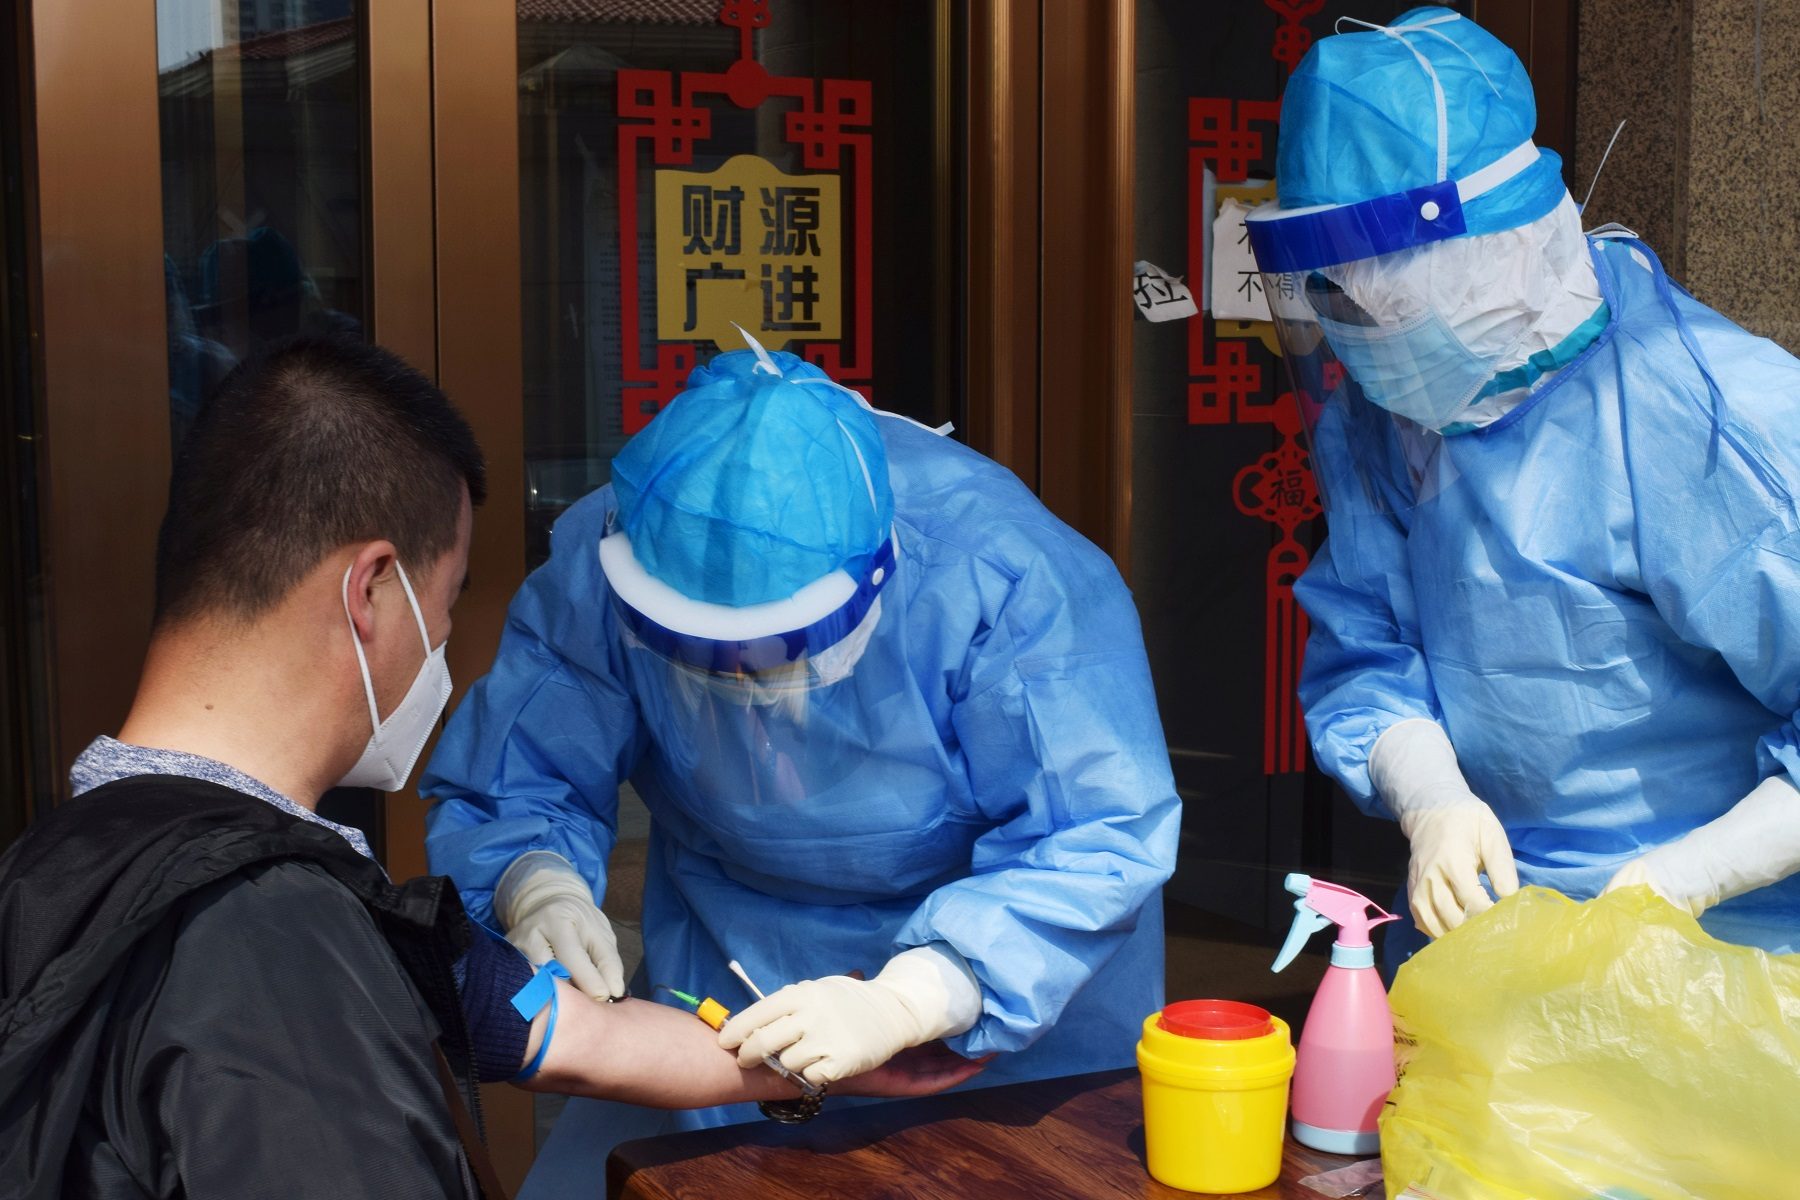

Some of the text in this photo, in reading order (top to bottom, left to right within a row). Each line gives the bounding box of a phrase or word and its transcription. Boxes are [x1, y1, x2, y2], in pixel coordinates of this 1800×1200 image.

[683, 185, 821, 256] 财源
[684, 262, 821, 331] 广进
[1270, 469, 1307, 507] 福
